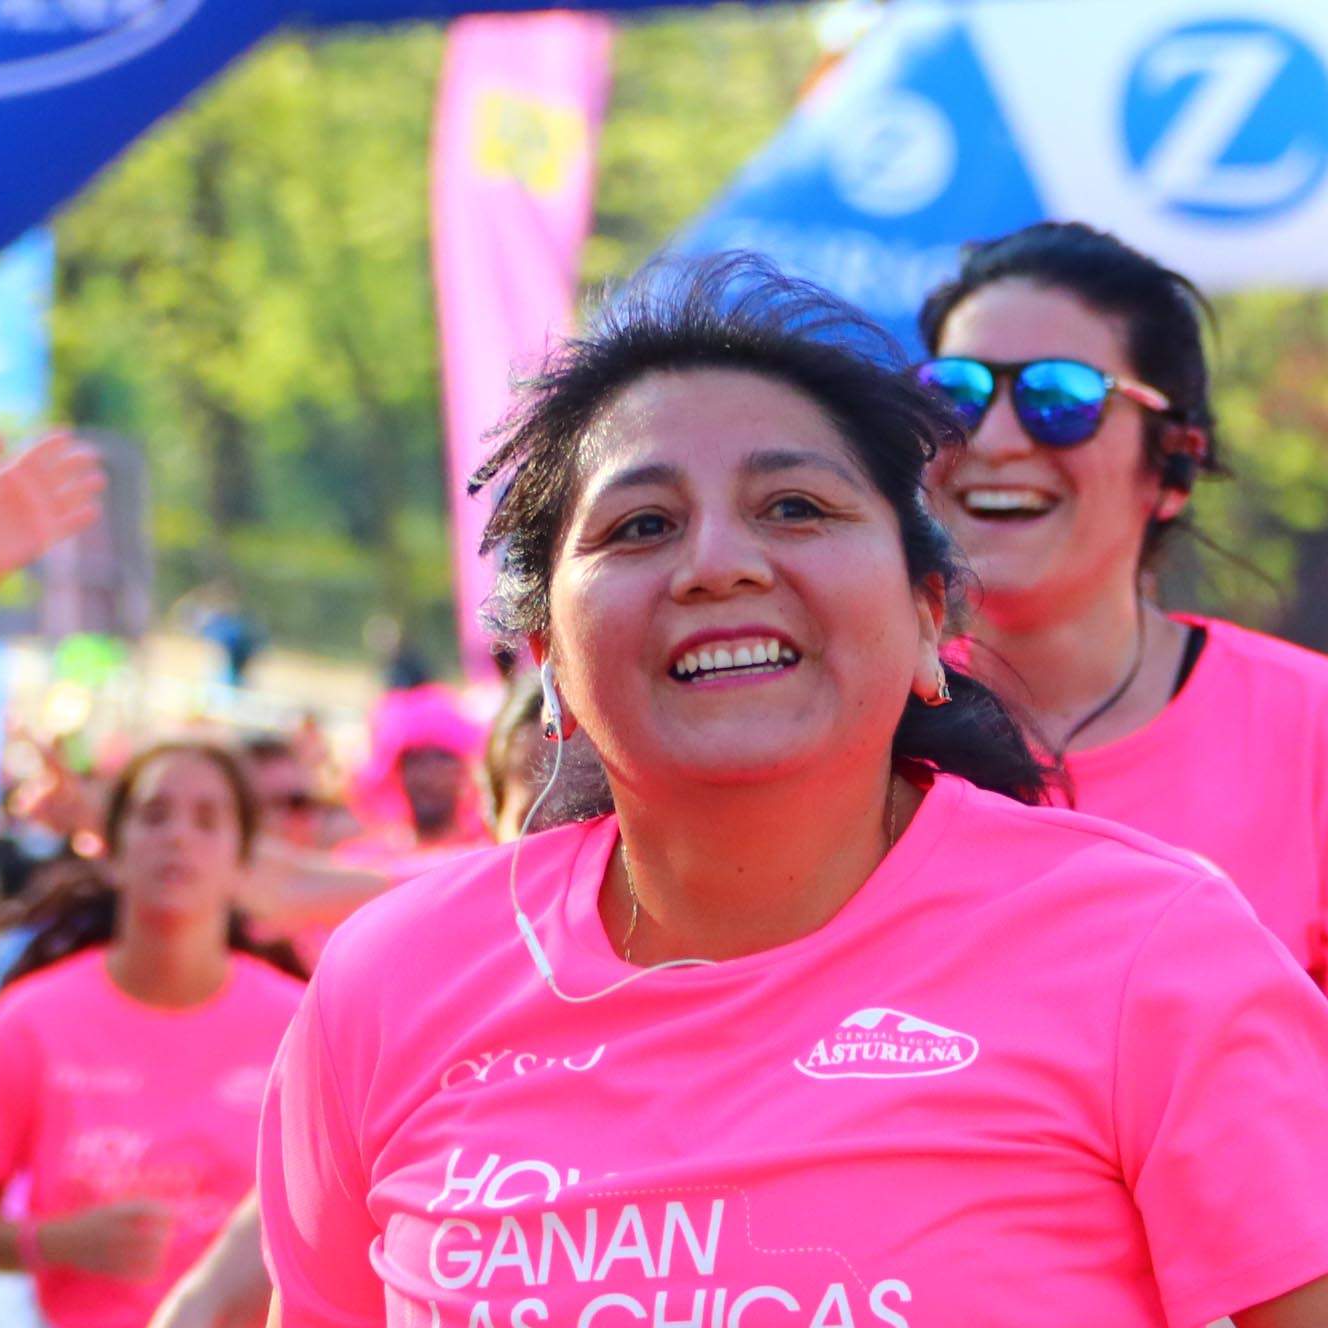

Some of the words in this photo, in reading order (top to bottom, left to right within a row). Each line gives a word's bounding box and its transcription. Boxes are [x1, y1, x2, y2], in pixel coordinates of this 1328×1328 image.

[805, 1038, 963, 1067] ASTURIANA
[425, 1147, 584, 1213] HO
[427, 1199, 725, 1290] GANAN
